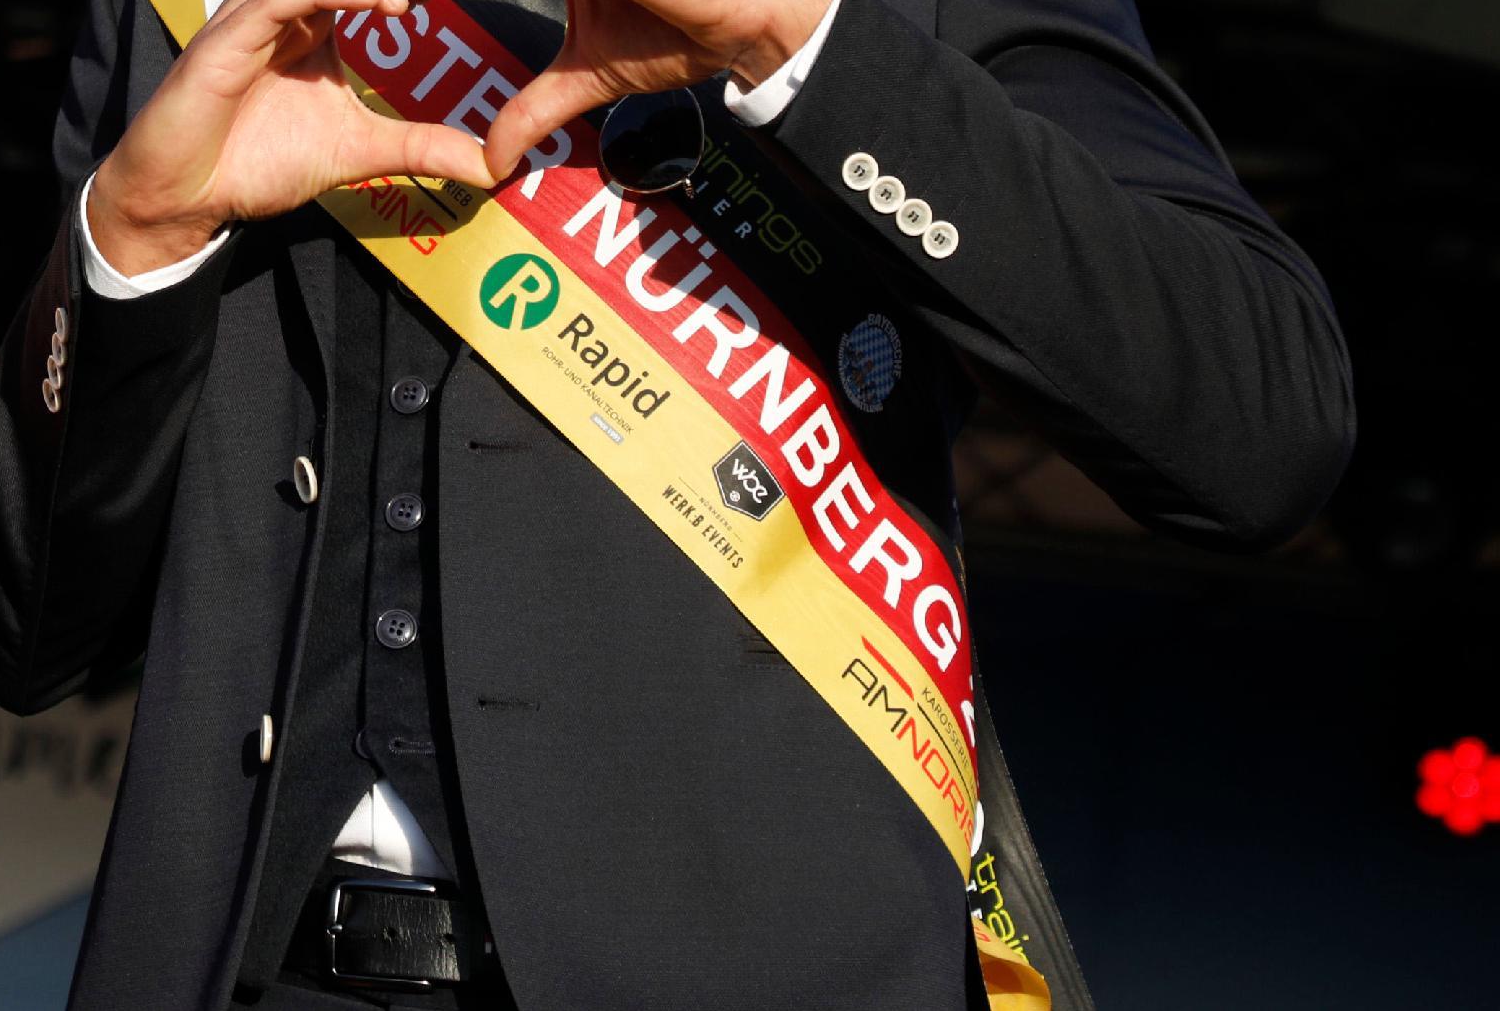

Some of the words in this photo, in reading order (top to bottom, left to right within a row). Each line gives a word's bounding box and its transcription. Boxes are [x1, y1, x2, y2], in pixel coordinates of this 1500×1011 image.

[702, 136, 824, 275] inings
[335, 4, 572, 201] STER
[561, 180, 962, 673] NÜRNBERG
[541, 345, 565, 369] ROHR-
[564, 367, 582, 386] UND
[581, 383, 635, 435] KANALTECHNIK
[557, 312, 671, 420] Rapid
[701, 524, 744, 569] EVENTS
[841, 658, 974, 852] AMNORIS
